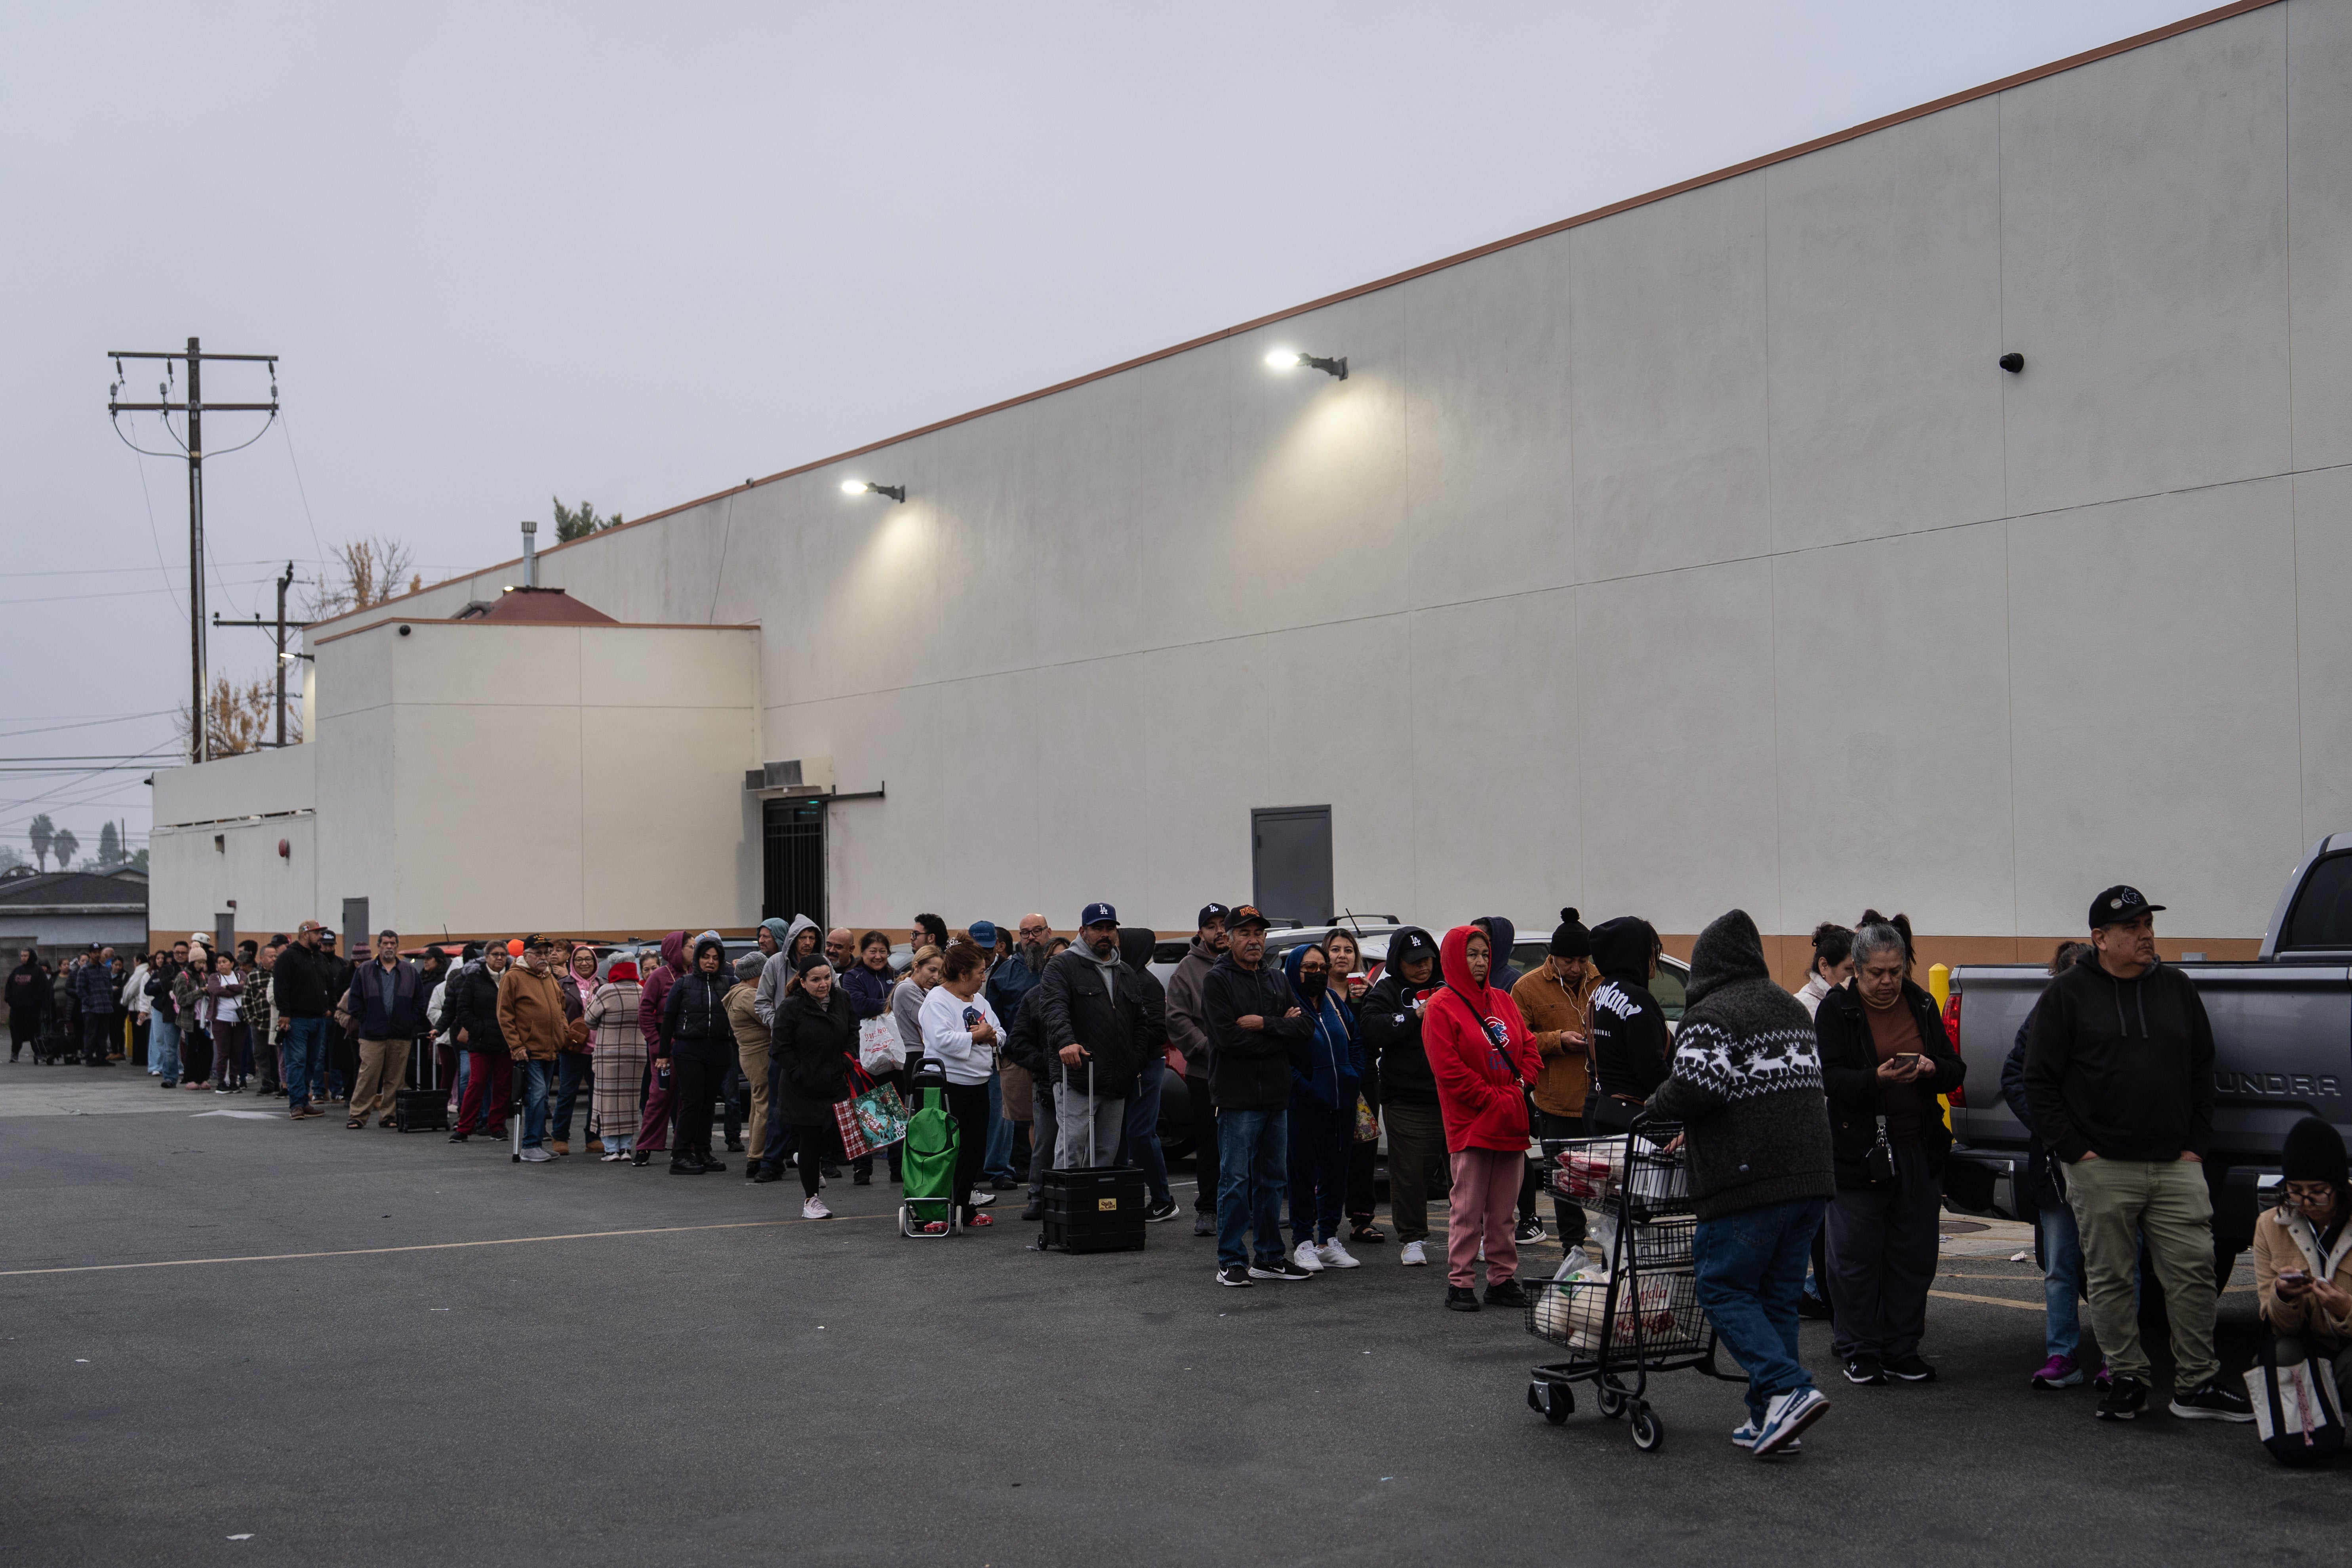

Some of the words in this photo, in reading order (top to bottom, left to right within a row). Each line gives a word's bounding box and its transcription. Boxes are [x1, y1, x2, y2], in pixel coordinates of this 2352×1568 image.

[1099, 904, 1108, 915] LA
[1410, 935, 1421, 946] LA
[2214, 1072, 2341, 1096] UNDRA
